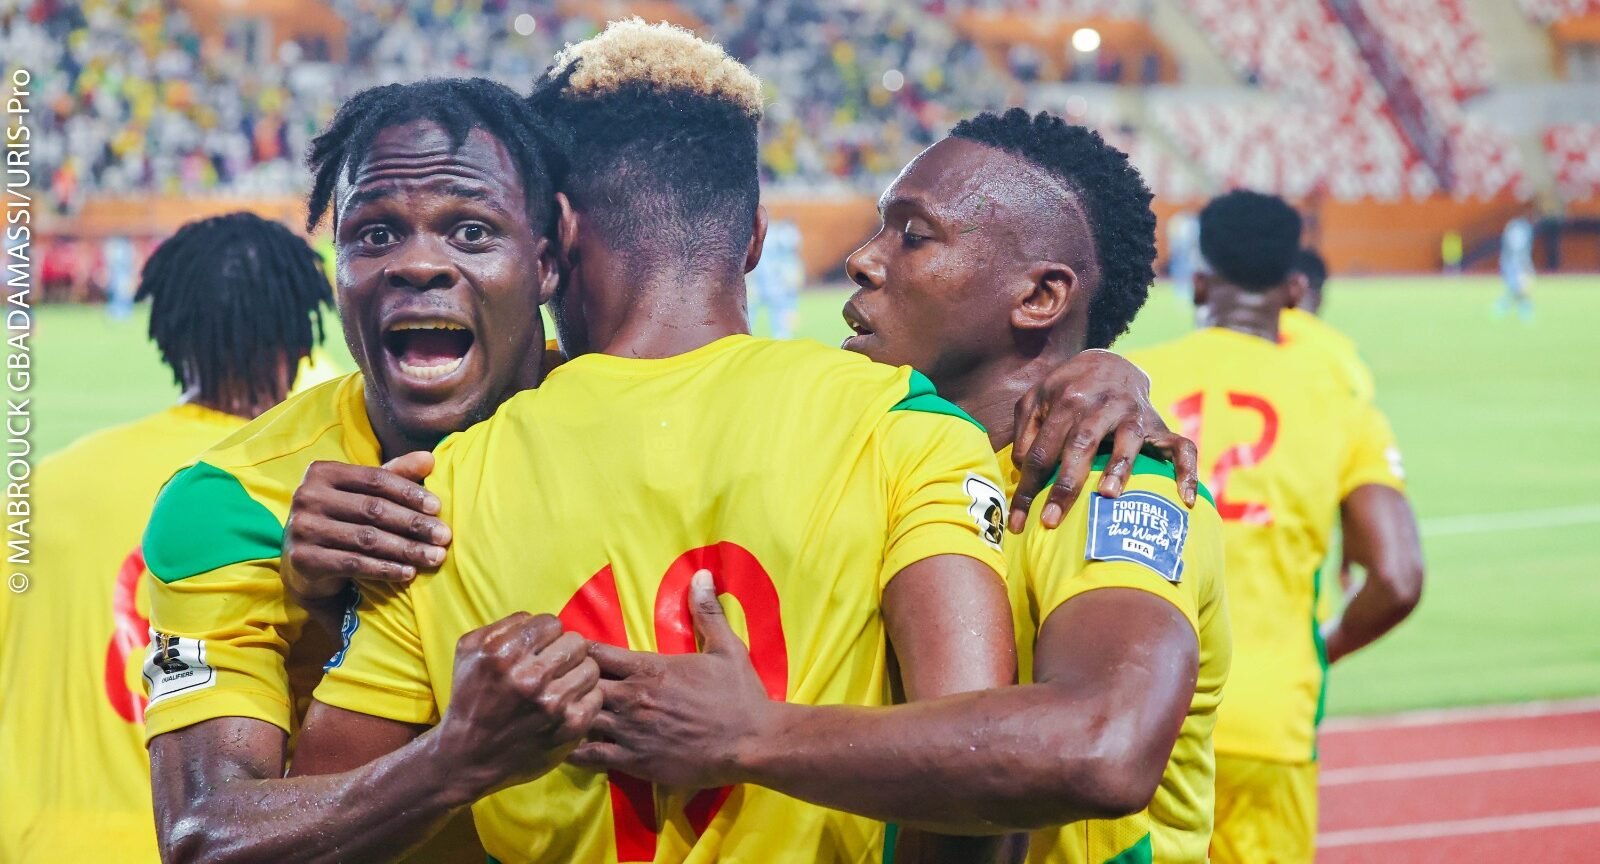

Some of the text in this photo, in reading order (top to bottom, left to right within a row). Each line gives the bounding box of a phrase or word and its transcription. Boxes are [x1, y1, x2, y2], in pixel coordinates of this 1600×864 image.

[1113, 501, 1168, 521] FOOTBALL
[1112, 509, 1168, 535] UNITES
[1107, 523, 1130, 536] the
[1127, 541, 1149, 554] FIFA
[161, 671, 194, 683] QUALIFIERS
